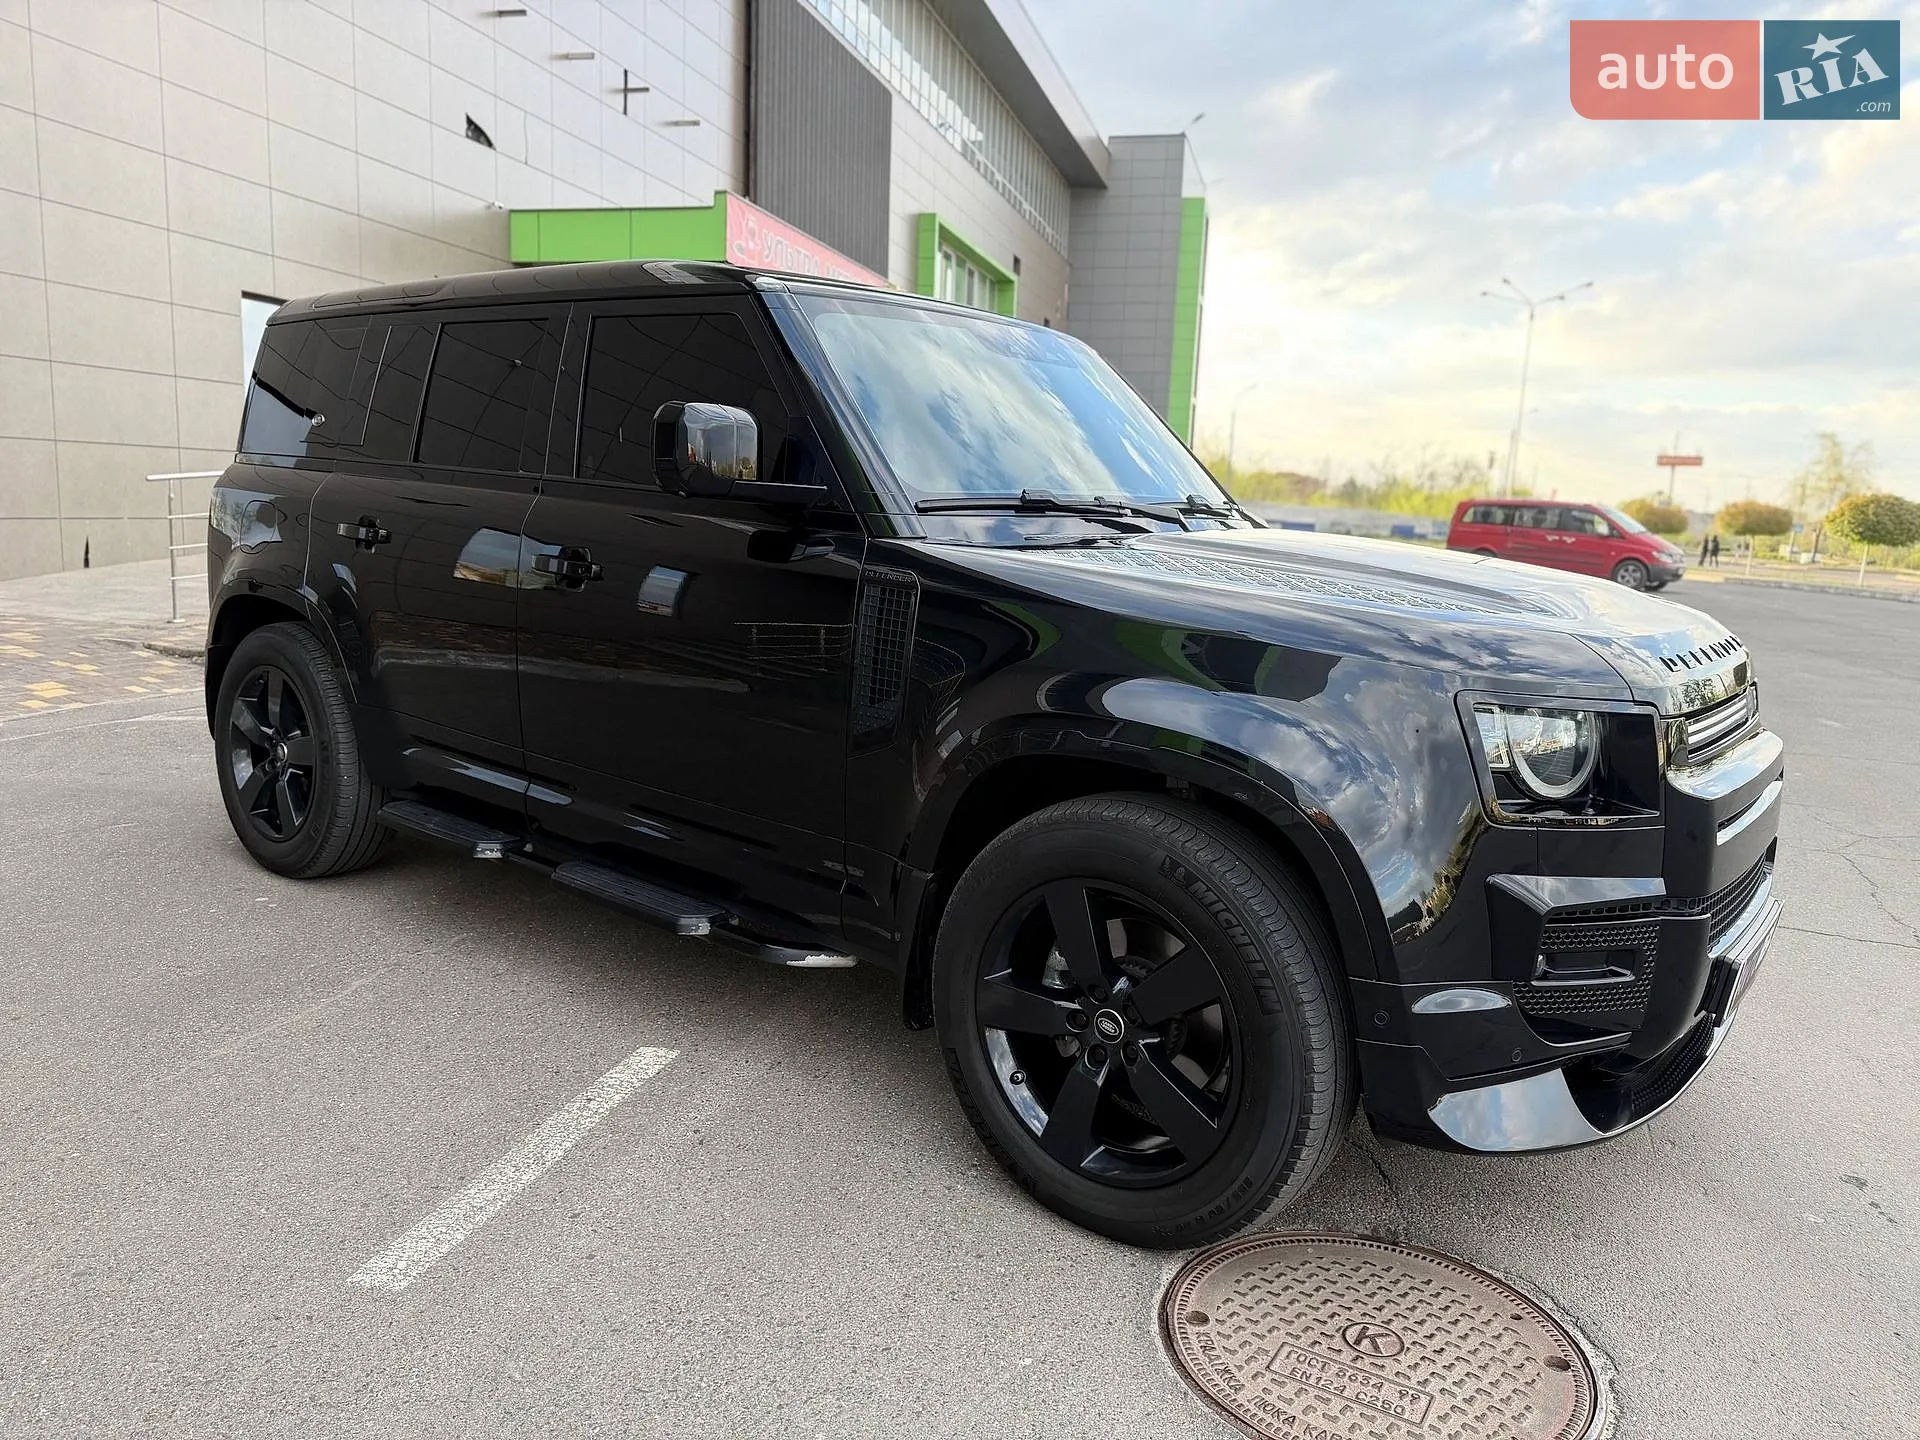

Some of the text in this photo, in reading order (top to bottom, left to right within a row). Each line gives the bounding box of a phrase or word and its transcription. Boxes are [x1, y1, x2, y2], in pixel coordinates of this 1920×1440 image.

[1187, 880, 1283, 1015] MICHELIN
[1289, 1366, 1312, 1382] EN
[1314, 1376, 1347, 1395] 124
